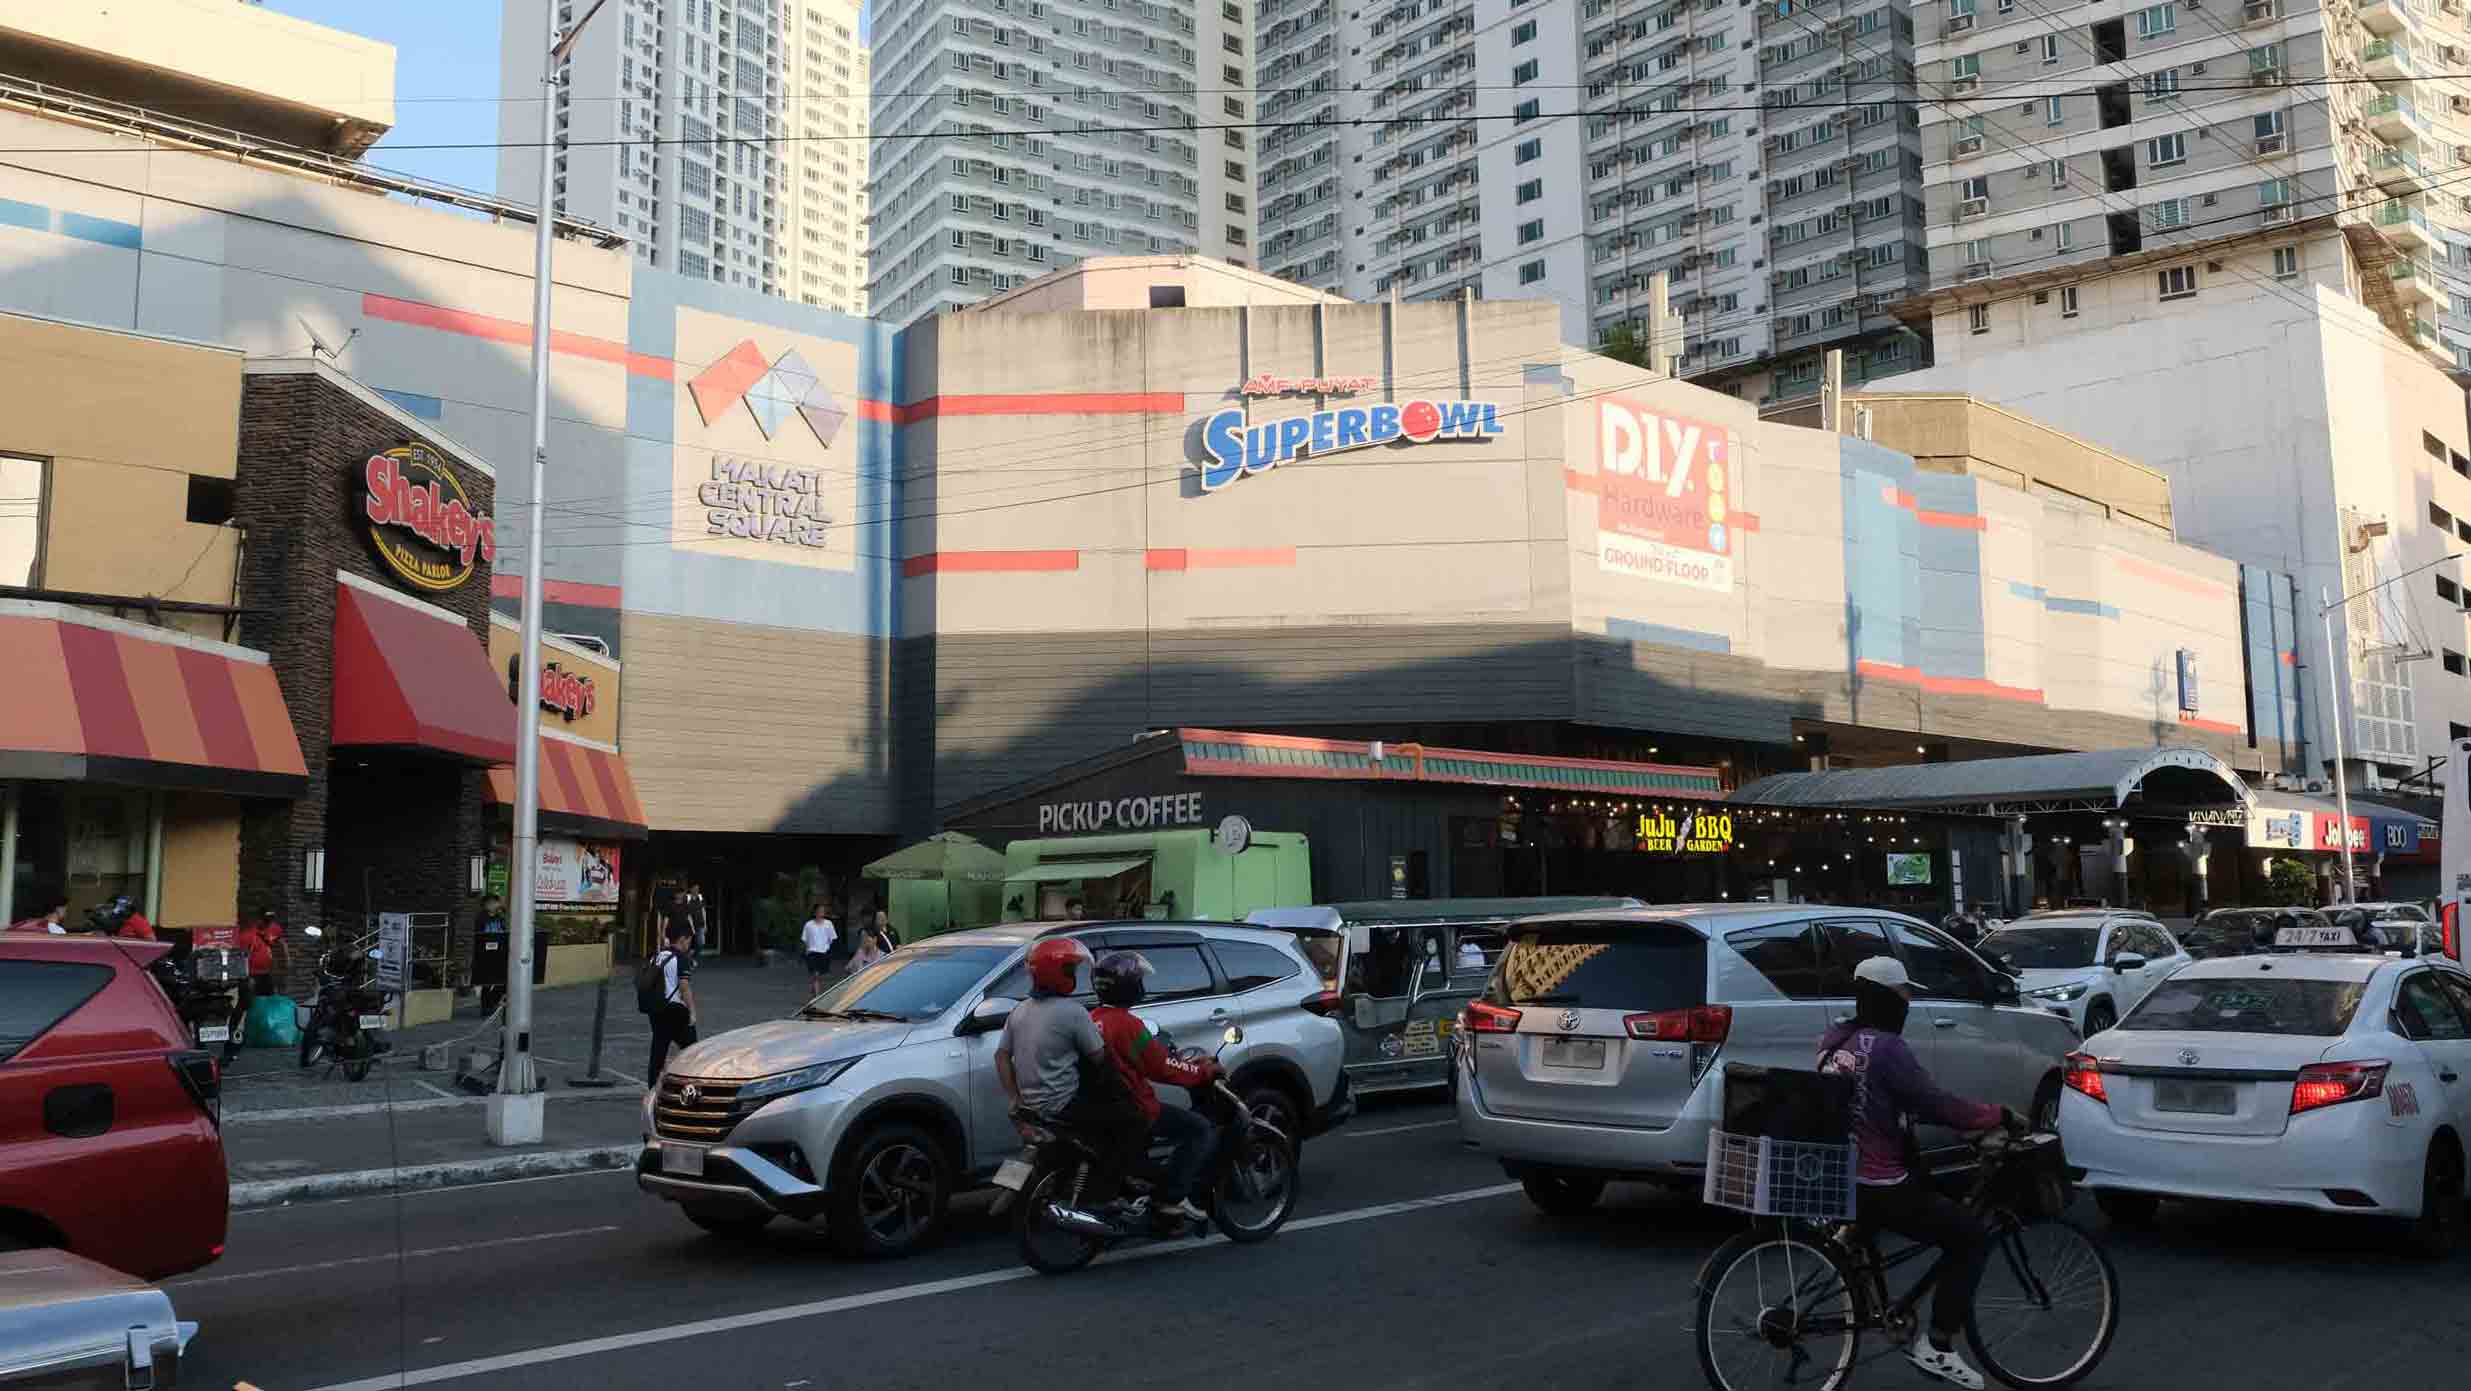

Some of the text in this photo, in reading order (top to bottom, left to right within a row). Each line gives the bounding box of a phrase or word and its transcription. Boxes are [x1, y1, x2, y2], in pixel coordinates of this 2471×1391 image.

[1202, 400, 1504, 490] SUPERBOWL
[711, 455, 825, 496] MAKATI
[366, 455, 496, 566] Shakey's
[699, 480, 832, 523] CENTRAL
[1605, 484, 1704, 529] Hardware
[708, 511, 825, 548] SQUARE
[394, 545, 451, 577] PIZZA PARLOR
[1604, 547, 1664, 573] GROUND
[1040, 792, 1202, 832] PICKUP COFFEE
[1696, 815, 1733, 843] BBQ
[1648, 839, 1723, 852] BEER GARDEN
[2387, 824, 2407, 847] BDO
[2320, 930, 2340, 941] TAXI
